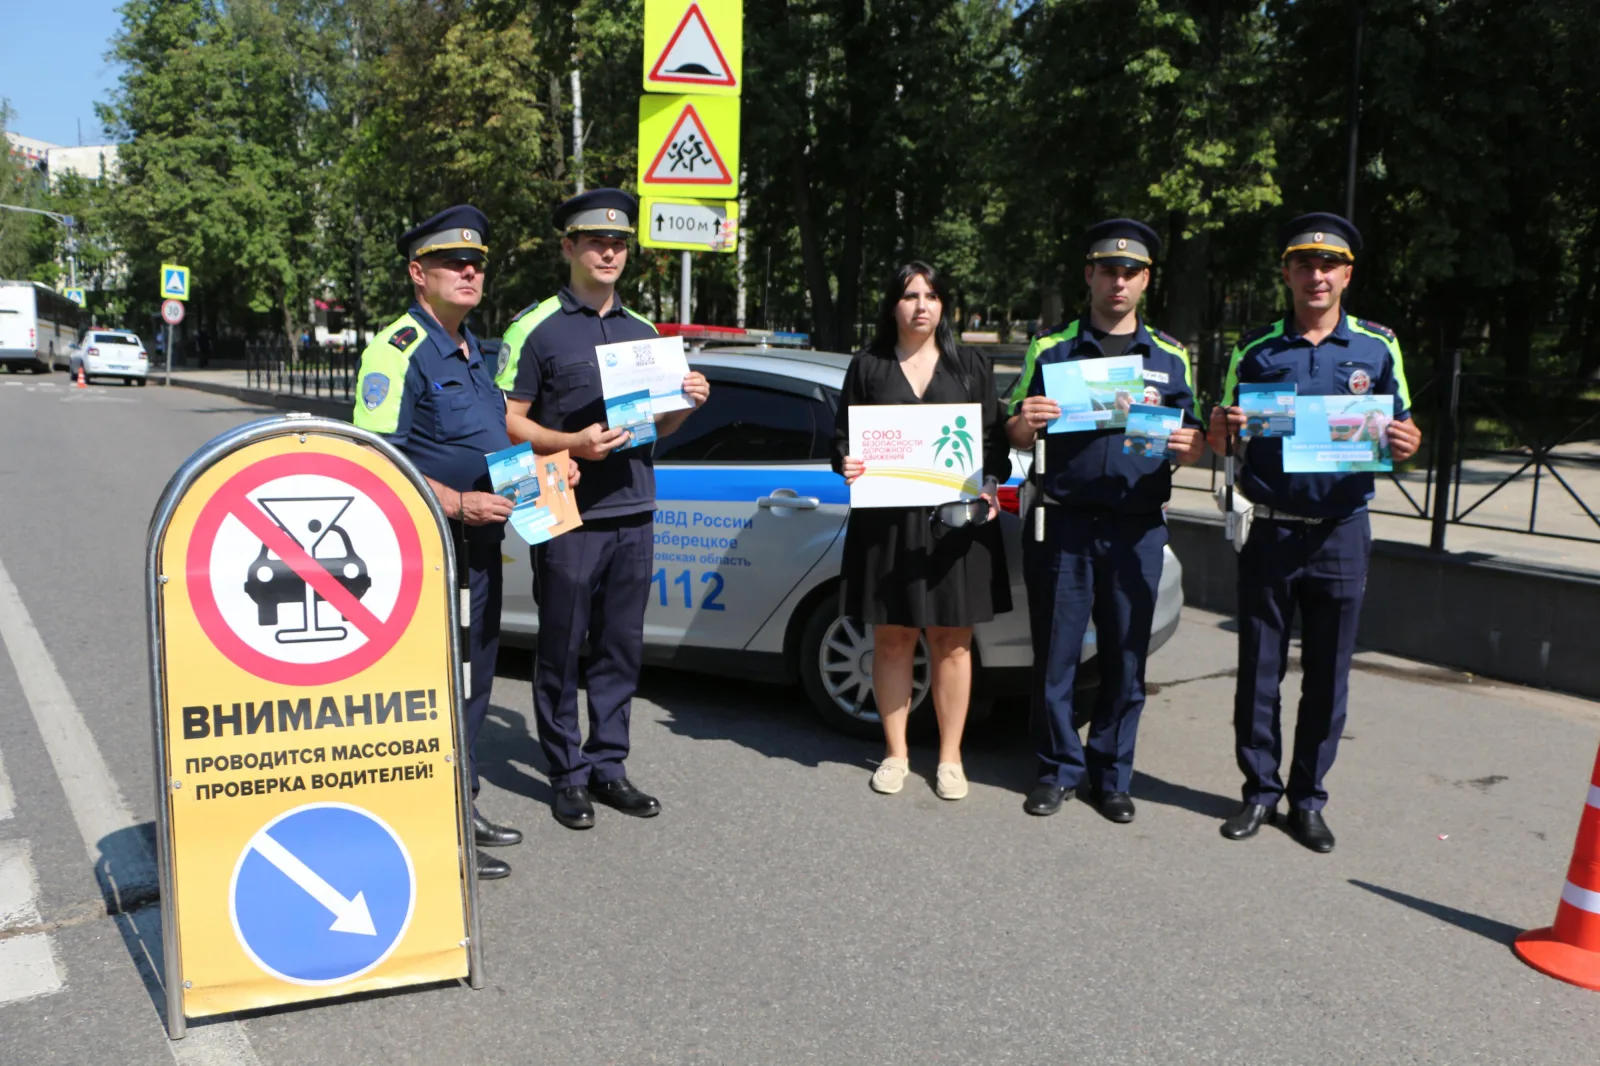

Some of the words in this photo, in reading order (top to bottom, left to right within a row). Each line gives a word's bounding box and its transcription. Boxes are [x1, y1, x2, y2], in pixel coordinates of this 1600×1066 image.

[668, 216, 695, 231] 100
[167, 305, 179, 316] 30
[862, 430, 902, 440] СОЮЗ
[653, 510, 687, 528] МВД
[692, 512, 753, 529] России
[699, 553, 751, 567] область
[651, 567, 725, 611] 112
[182, 689, 438, 739] ВНИМАНИЕ!
[185, 746, 326, 774] ПРОВОДИТСЯ
[332, 737, 440, 761] МАССОВАЯ
[196, 776, 306, 800] ПРОВЕРКА
[311, 762, 434, 789] ВОДИТЕЛЕЙ!
